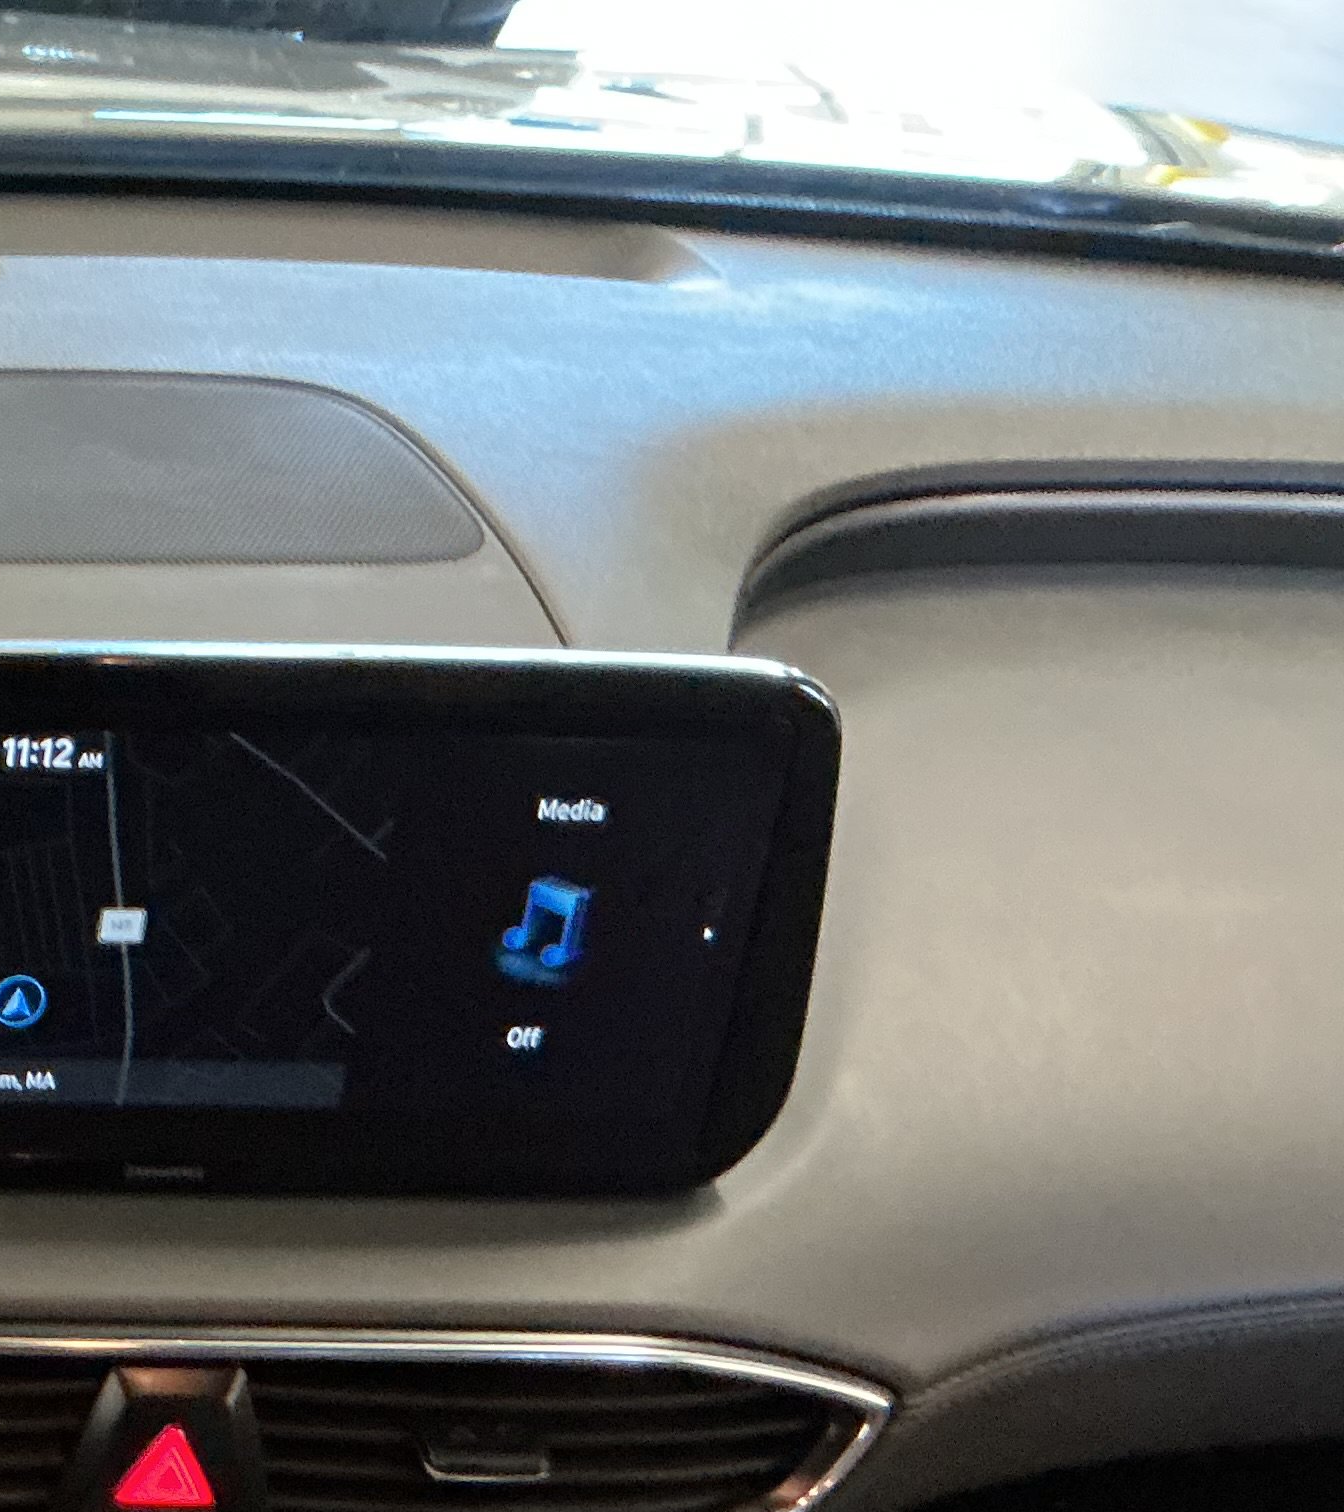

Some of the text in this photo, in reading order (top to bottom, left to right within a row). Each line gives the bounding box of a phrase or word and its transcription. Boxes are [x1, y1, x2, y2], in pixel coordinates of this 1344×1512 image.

[2, 737, 104, 768] 11:12 AM
[537, 799, 605, 822] Media
[506, 1027, 545, 1050] Off
[25, 1072, 56, 1092] MA
